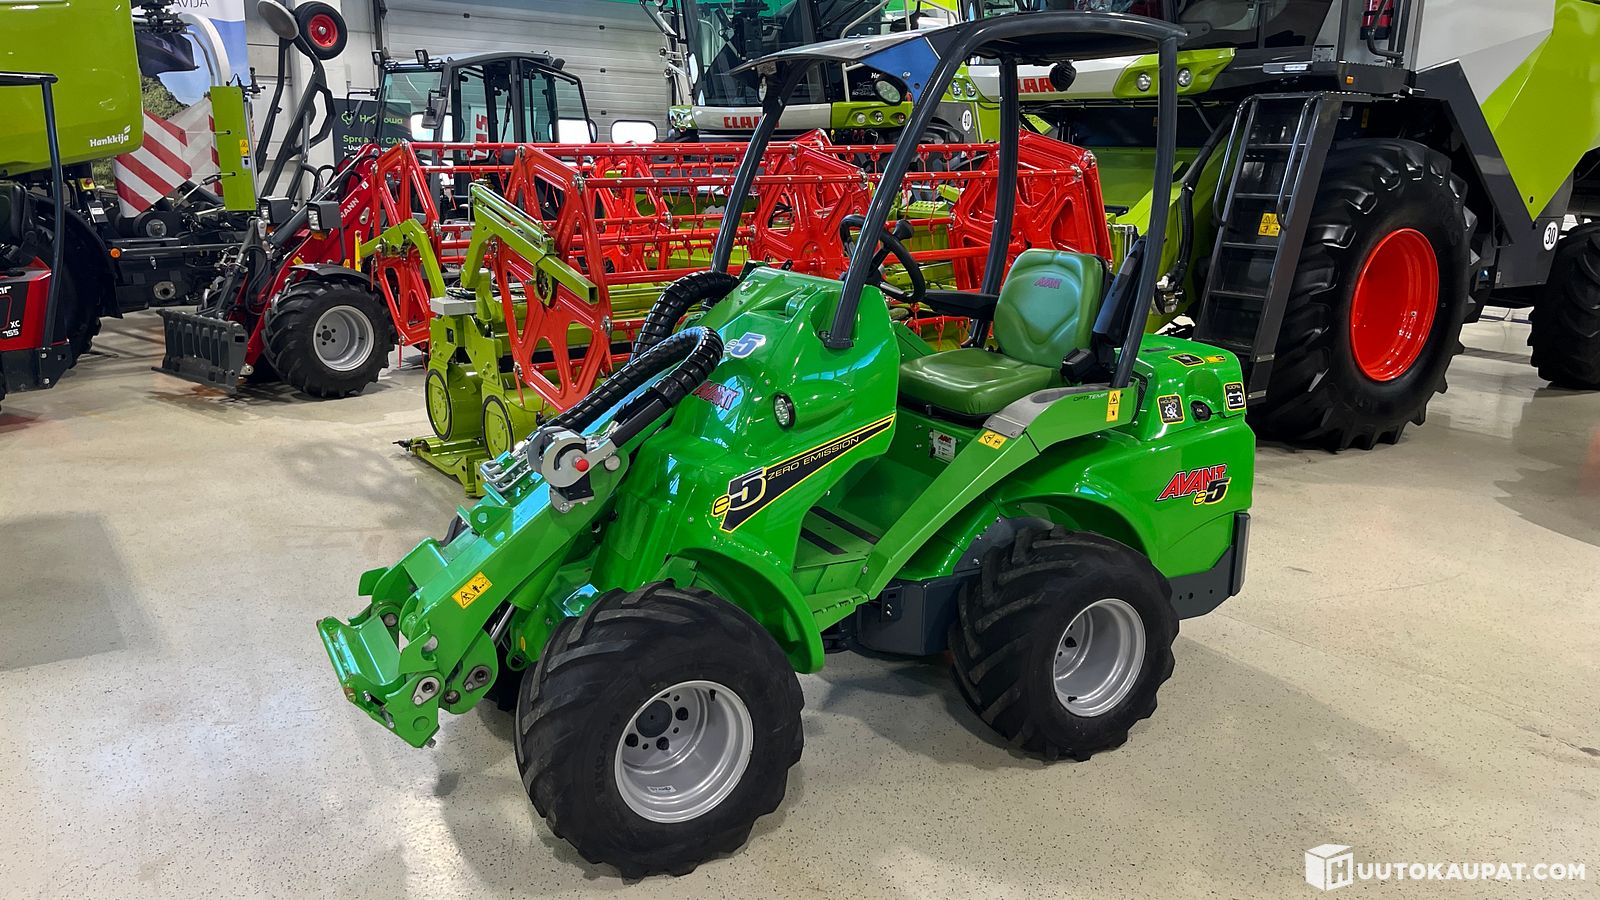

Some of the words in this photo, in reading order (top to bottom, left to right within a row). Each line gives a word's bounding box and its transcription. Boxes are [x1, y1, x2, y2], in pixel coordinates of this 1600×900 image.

[963, 112, 971, 128] 40
[89, 133, 129, 147] Hankkija
[1545, 226, 1557, 245] 30
[2, 328, 20, 338] 755
[9, 320, 21, 329] XC
[691, 380, 739, 411] AVANT
[767, 462, 800, 481] ZERO
[803, 436, 860, 466] EMISSION
[1154, 463, 1227, 502] AVANT
[1193, 476, 1232, 506] e5
